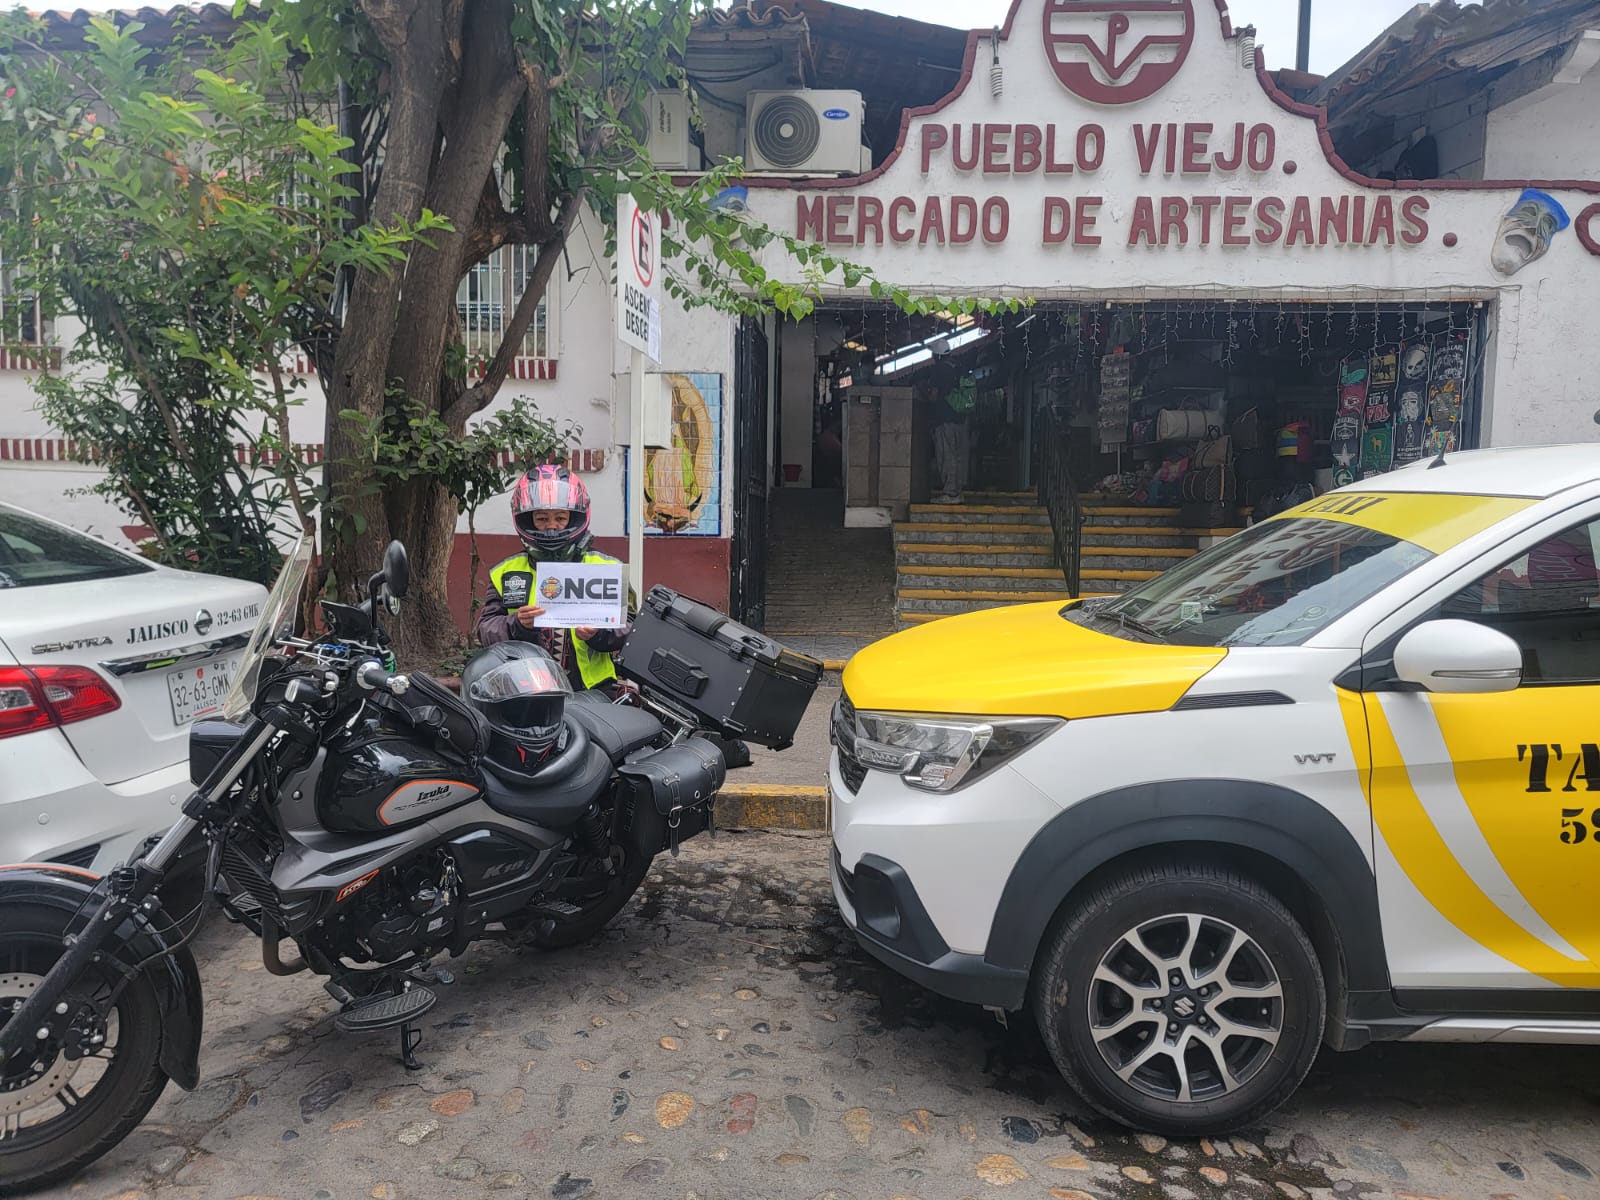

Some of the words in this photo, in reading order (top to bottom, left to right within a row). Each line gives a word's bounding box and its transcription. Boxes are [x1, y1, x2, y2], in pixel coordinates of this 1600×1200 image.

[921, 122, 1106, 176] PUEBLO
[1132, 122, 1298, 176] VIEJO.
[796, 195, 1010, 247] MERCADO
[1042, 196, 1104, 247] DE
[1127, 195, 1458, 248] ARTESANIAS.
[126, 618, 189, 645] JALISCO
[216, 608, 242, 627] 32-63
[243, 603, 260, 621] GMK
[31, 634, 114, 655] SENTRA
[173, 673, 231, 708] 32-63-GMK
[193, 698, 218, 711] JALISCO
[1293, 752, 1337, 765] VVT
[416, 784, 450, 802] Izuka
